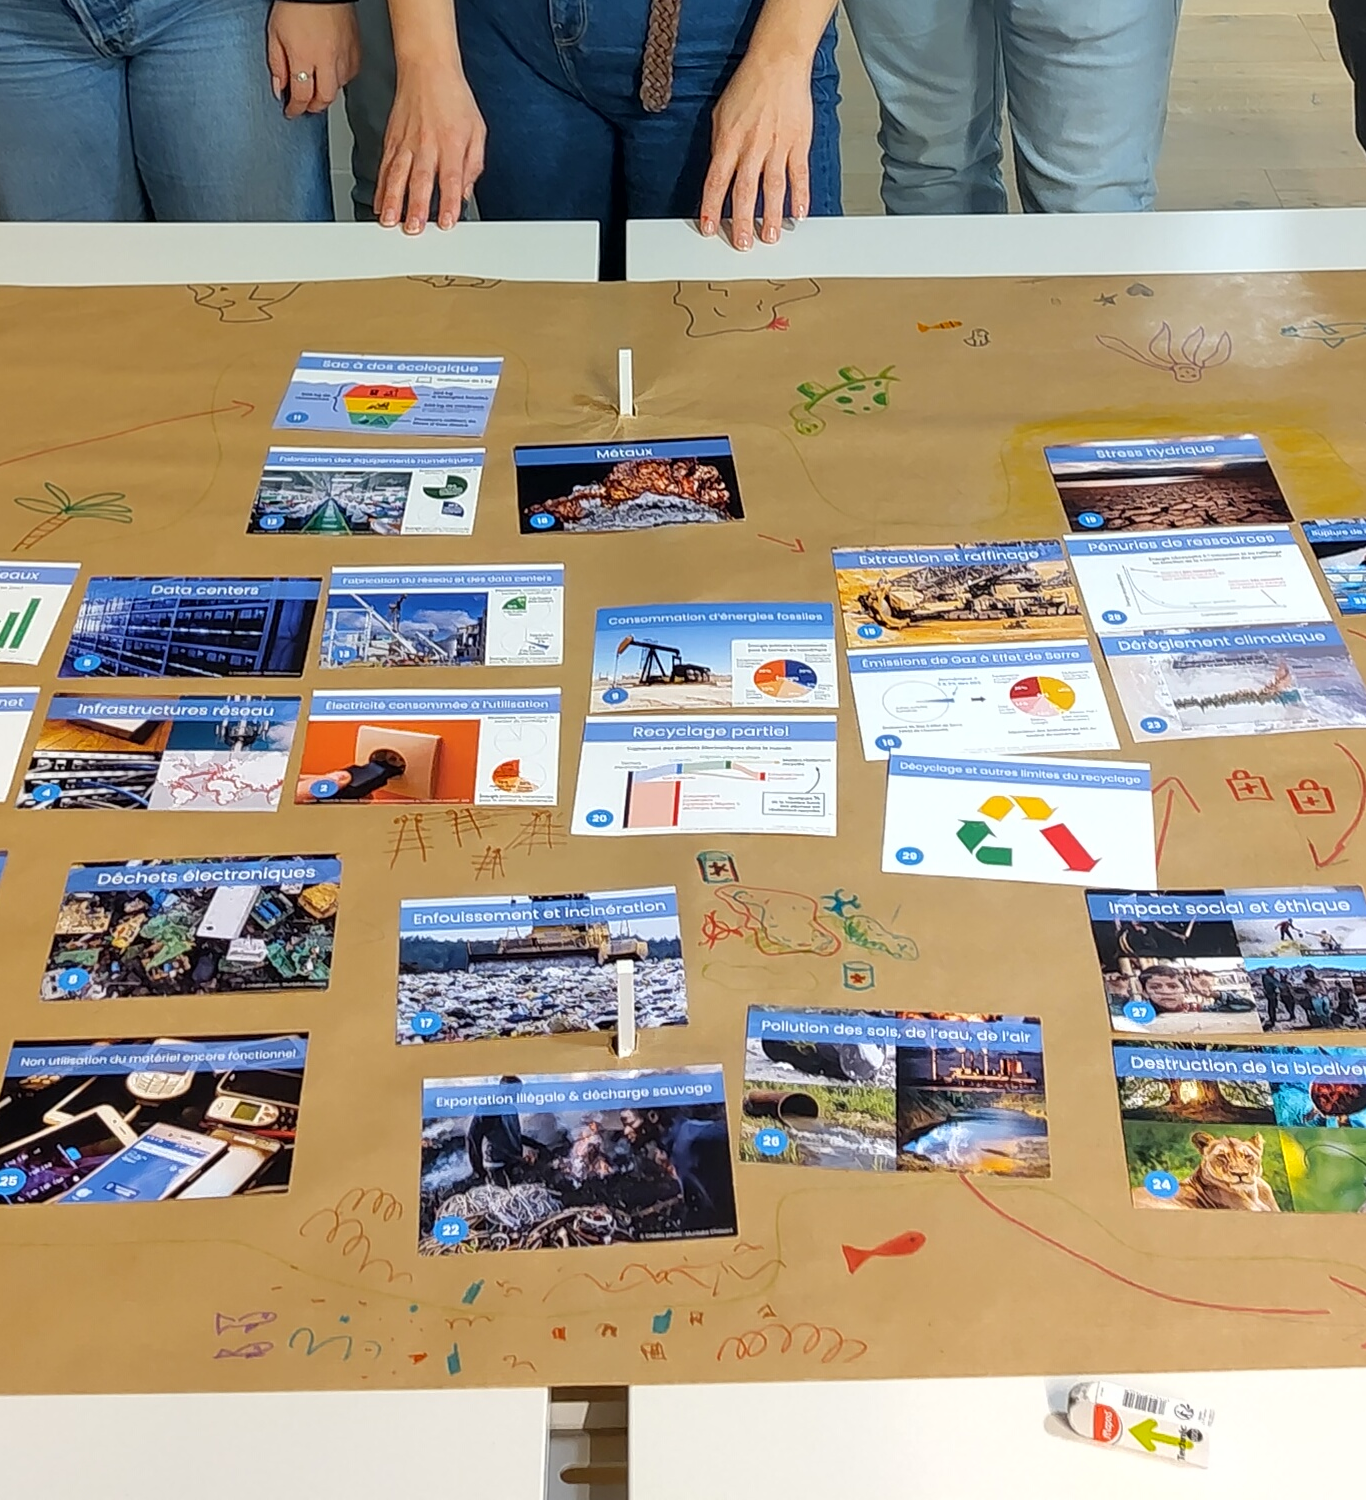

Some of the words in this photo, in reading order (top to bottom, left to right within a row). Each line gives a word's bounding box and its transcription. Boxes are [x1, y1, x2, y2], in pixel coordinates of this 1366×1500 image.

[322, 359, 349, 369] Sac
[354, 360, 364, 370] à
[367, 361, 393, 371] dos
[397, 361, 479, 374] écologique
[596, 447, 654, 459] Métaux
[1096, 447, 1143, 459] Stress
[1145, 444, 1215, 458] hydrique
[279, 455, 333, 464] Fabrication
[353, 456, 416, 465] équipements
[417, 456, 474, 465] numériques
[1310, 526, 1349, 538] Rupture
[1088, 541, 1158, 553] Pénuries
[1161, 538, 1182, 550] de
[1186, 534, 1275, 548] ressources
[858, 552, 940, 566] Extraction
[944, 552, 960, 563] et
[963, 548, 1039, 563] raffinage
[342, 576, 400, 586] Fabrication
[417, 575, 453, 585] réseau
[467, 575, 485, 584] des
[487, 575, 512, 584] data
[514, 574, 552, 583] centers
[151, 584, 192, 596] Data
[196, 585, 259, 596] centers
[607, 613, 706, 626] Consommation
[708, 610, 774, 624] d'énergies
[775, 610, 823, 621] fossiles
[1117, 636, 1231, 652] Dérèglement
[1234, 631, 1327, 648] climatique
[861, 656, 928, 669] Émissions
[930, 655, 949, 667] de
[951, 654, 977, 666] Gaz
[993, 651, 1022, 664] Effet
[1024, 651, 1043, 663] de
[1045, 649, 1080, 662] Serre
[77, 703, 208, 716] Infrastructures
[211, 702, 275, 717] réseau
[325, 698, 386, 711] Électricité
[388, 699, 468, 711] consommée
[482, 698, 550, 710] l'utilisation
[633, 724, 727, 741] Recyclage
[730, 725, 790, 741] partiel
[1146, 720, 1162, 730] 23
[900, 760, 963, 776] Décyclage
[964, 765, 979, 775] et
[980, 766, 1019, 777] autres
[1021, 768, 1060, 780] limites
[1062, 771, 1080, 781] du
[1081, 773, 1142, 786] recyclage
[591, 813, 608, 824] 20
[97, 869, 178, 886] Déchets
[181, 865, 317, 884] électroniques
[413, 908, 540, 927] Enfouissement
[543, 907, 562, 921] et
[564, 898, 667, 918] incinération
[1107, 898, 1181, 919] Impact
[1185, 896, 1245, 914] social
[1248, 898, 1270, 914] et
[1272, 894, 1351, 917] éthique
[1131, 1006, 1148, 1018] 27
[419, 1017, 434, 1029] 17
[761, 1019, 830, 1035] Pollution
[833, 1021, 864, 1037] des
[866, 1023, 902, 1041] sols,
[905, 1024, 927, 1040] de
[930, 1026, 974, 1044] l'eau,
[976, 1028, 999, 1043] de
[1001, 1029, 1031, 1045] l'air
[20, 1055, 47, 1068] Non
[48, 1053, 108, 1067] utilisation
[109, 1054, 127, 1065] du
[128, 1051, 181, 1065] matériel
[182, 1051, 225, 1063] encore
[227, 1047, 298, 1062] fonctionnel
[1130, 1054, 1238, 1074] Destruction
[1240, 1057, 1267, 1075] de
[1270, 1058, 1291, 1077] la
[435, 1092, 514, 1109] Exportation
[515, 1088, 566, 1107] illégale
[569, 1089, 580, 1102] &
[582, 1085, 650, 1103] décharge
[652, 1083, 713, 1099] sauvage
[0, 1175, 19, 1188] 25
[1151, 1178, 1172, 1192] 24
[441, 1222, 461, 1237] 22
